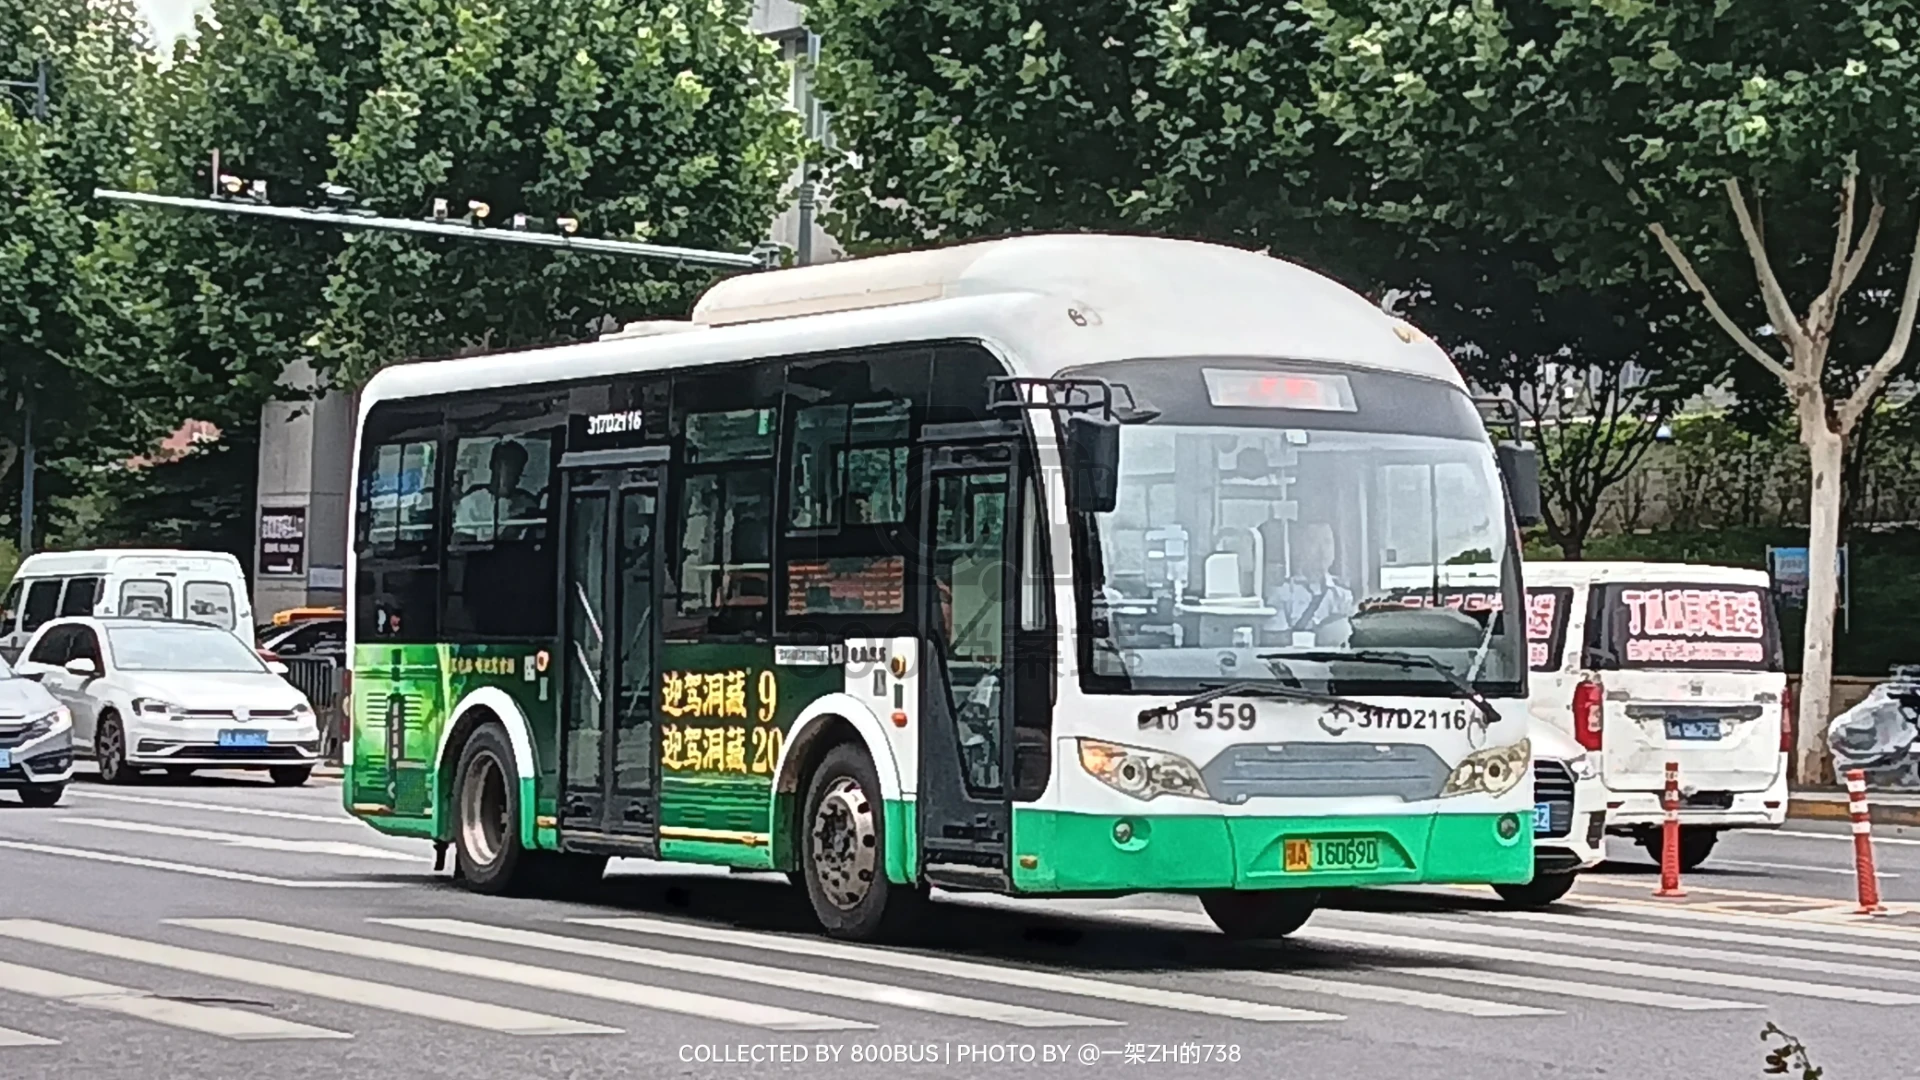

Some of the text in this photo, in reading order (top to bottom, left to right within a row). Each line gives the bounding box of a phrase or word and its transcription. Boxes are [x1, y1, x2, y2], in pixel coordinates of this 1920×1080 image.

[758, 670, 776, 722] 9
[1194, 703, 1256, 731] 559
[752, 727, 783, 773] 20
